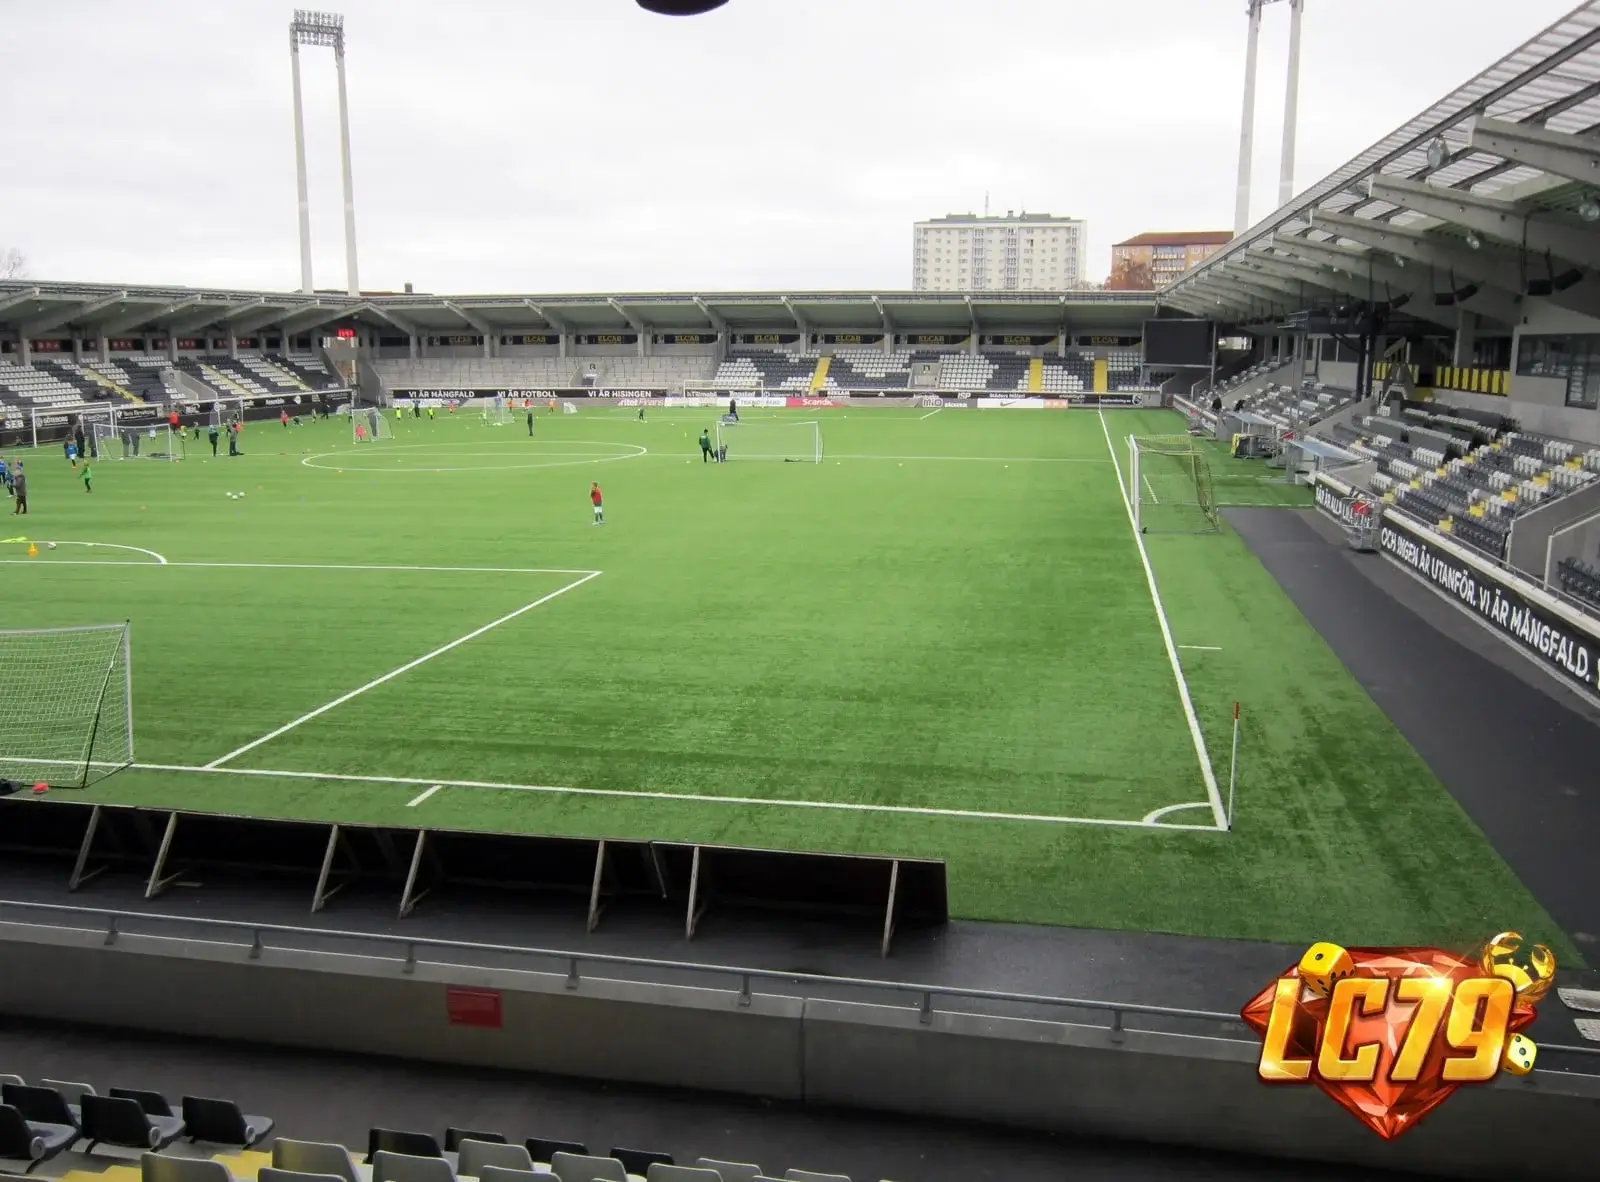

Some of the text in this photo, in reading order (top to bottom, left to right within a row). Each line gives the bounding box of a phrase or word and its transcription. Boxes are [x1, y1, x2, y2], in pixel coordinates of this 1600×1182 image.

[420, 389, 429, 398] ÄR
[432, 389, 475, 398] MÅNGFALD
[508, 389, 519, 398] ÄR
[521, 390, 558, 398] FOTBOLL
[587, 389, 652, 398] VI ÄR HISINGEN
[802, 398, 833, 406] Scandic
[1381, 527, 1397, 552] OCH
[1397, 536, 1419, 567] INGEN
[1419, 545, 1430, 576] ÄR
[1431, 557, 1477, 607] UTANFÖR.
[1479, 586, 1491, 615] VI
[1491, 588, 1509, 628] ÄR
[1510, 607, 1591, 682] MÅNGFALD.
